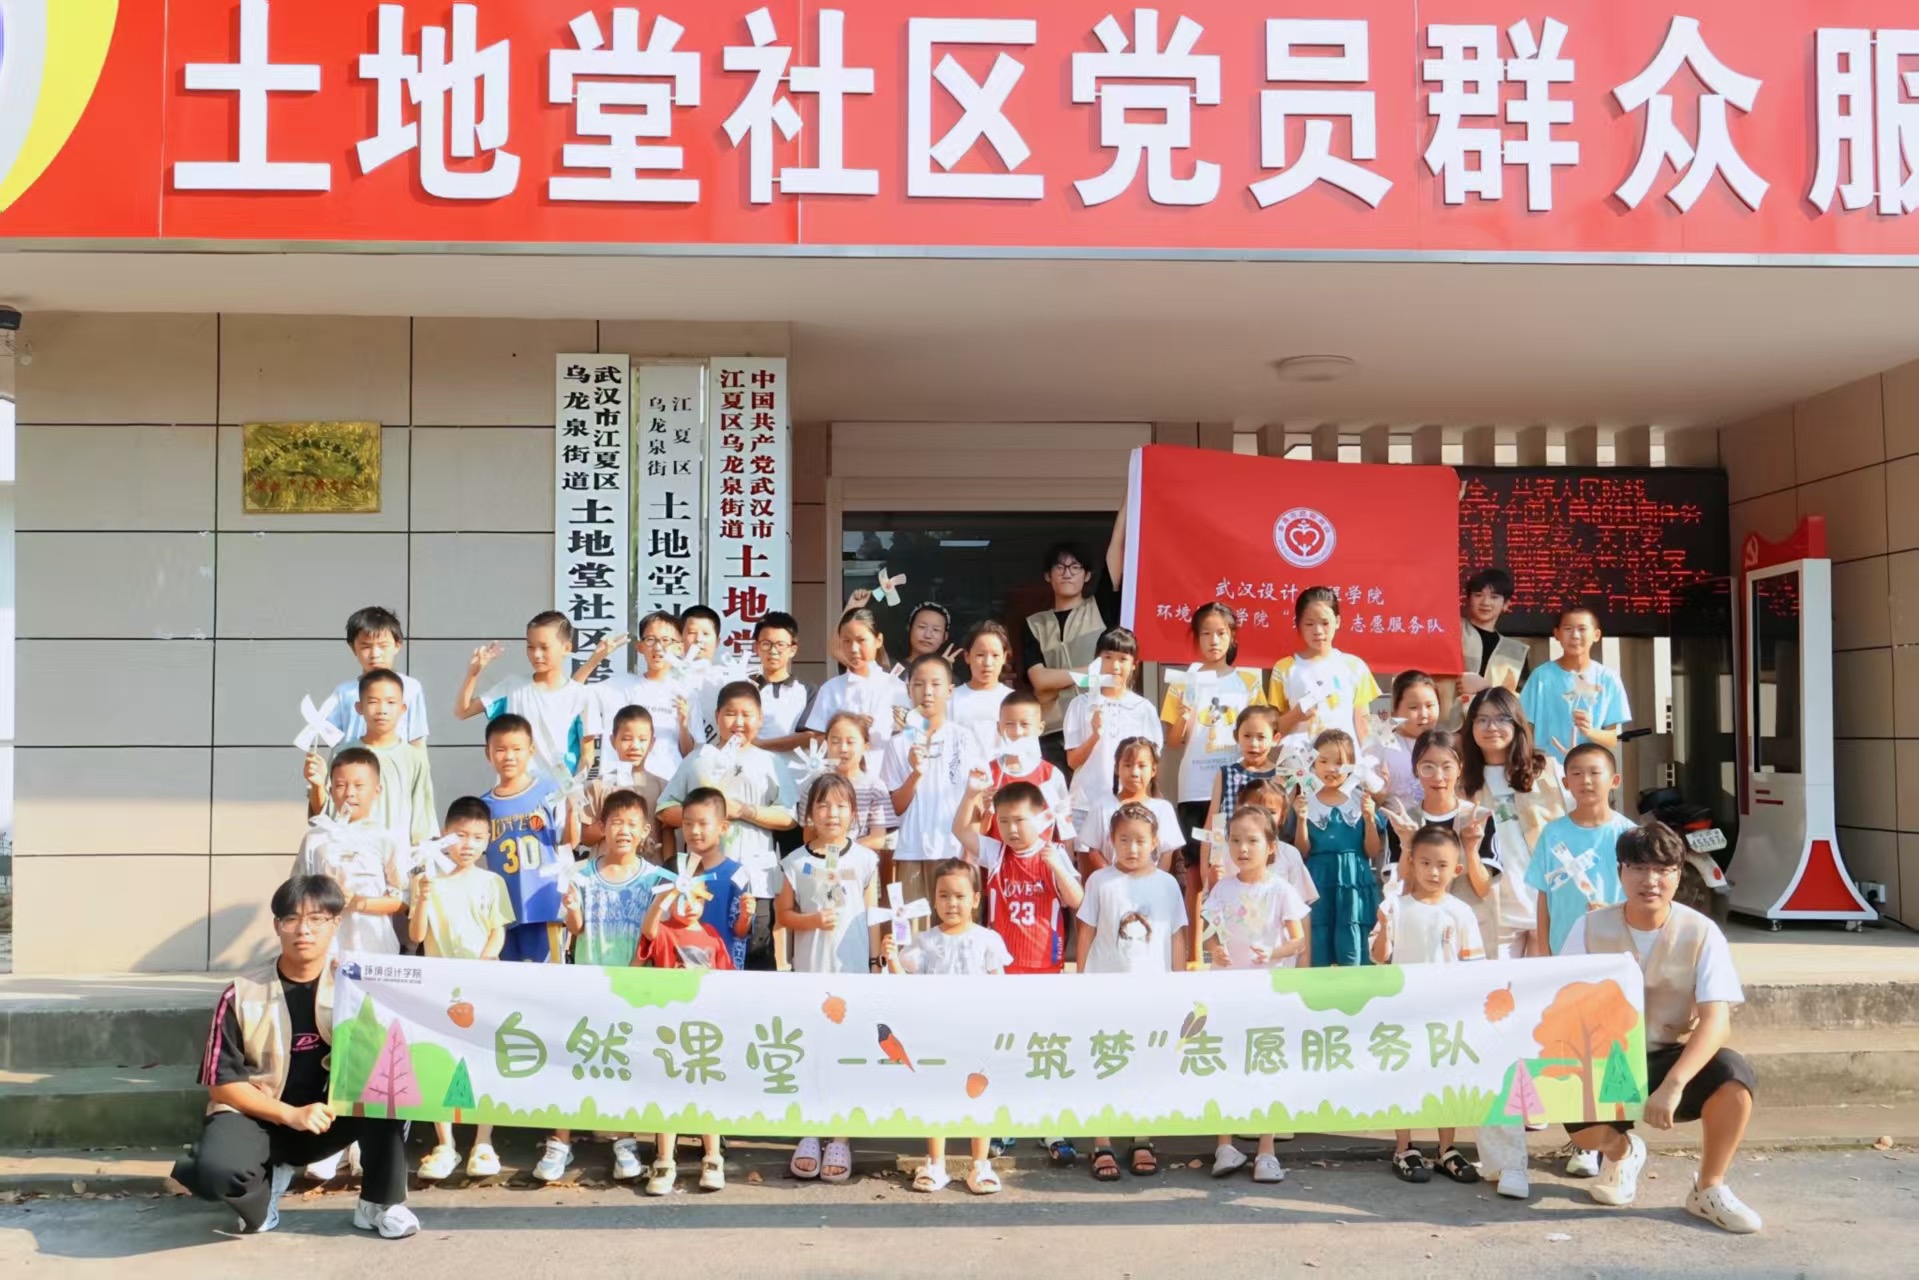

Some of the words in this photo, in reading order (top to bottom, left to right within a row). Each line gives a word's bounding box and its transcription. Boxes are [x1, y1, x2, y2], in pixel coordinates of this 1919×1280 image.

[562, 364, 590, 491] 乌龙泉街道
[593, 365, 622, 491] 武汉市江夏区
[648, 396, 667, 477] 乌龙泉街
[672, 396, 692, 476] 江夏区
[720, 369, 745, 539] 江夏区乌龙泉街道
[750, 369, 776, 539] 中国共产党武汉市
[1215, 577, 1385, 605] 武汉设计程学院
[499, 835, 541, 875] 30
[1008, 900, 1036, 926] 23
